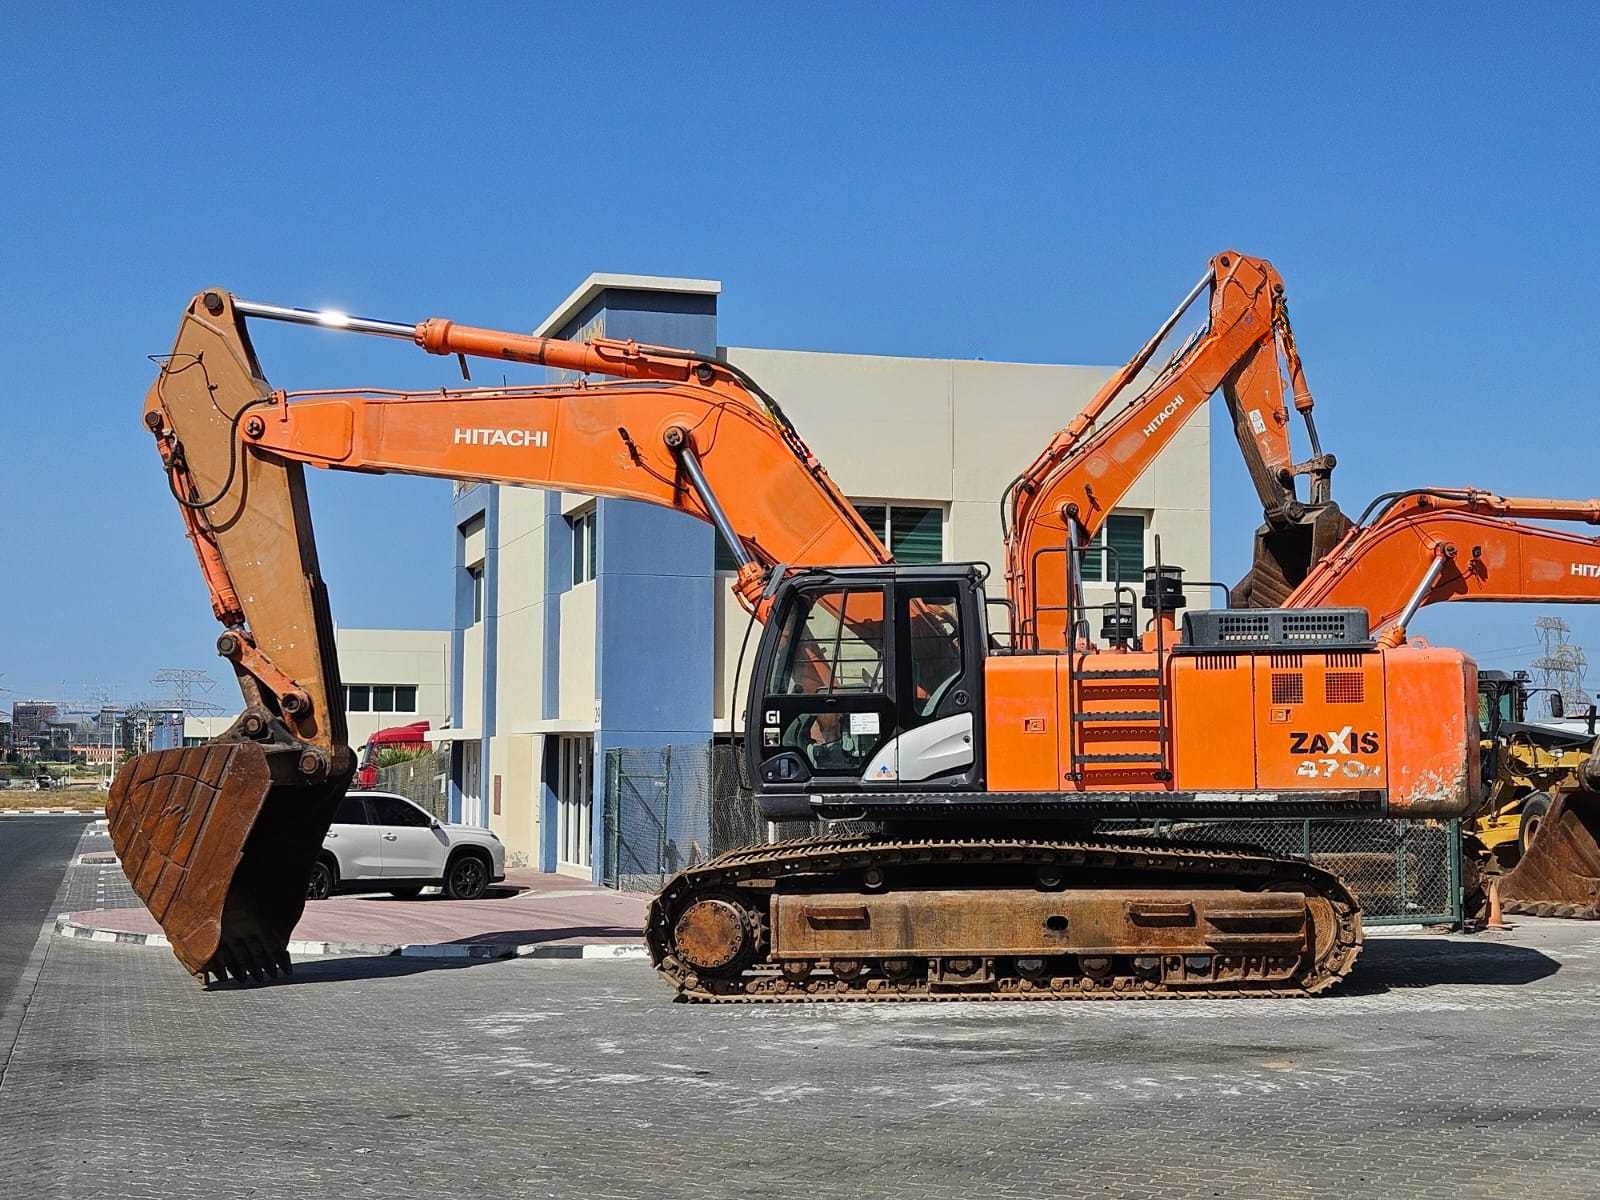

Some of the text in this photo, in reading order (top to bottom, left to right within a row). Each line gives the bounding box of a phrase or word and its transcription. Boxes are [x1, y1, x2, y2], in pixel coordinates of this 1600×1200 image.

[1143, 394, 1185, 437] HITACHI
[454, 428, 548, 447] HITACHI
[1290, 726, 1380, 755] ZAXIS
